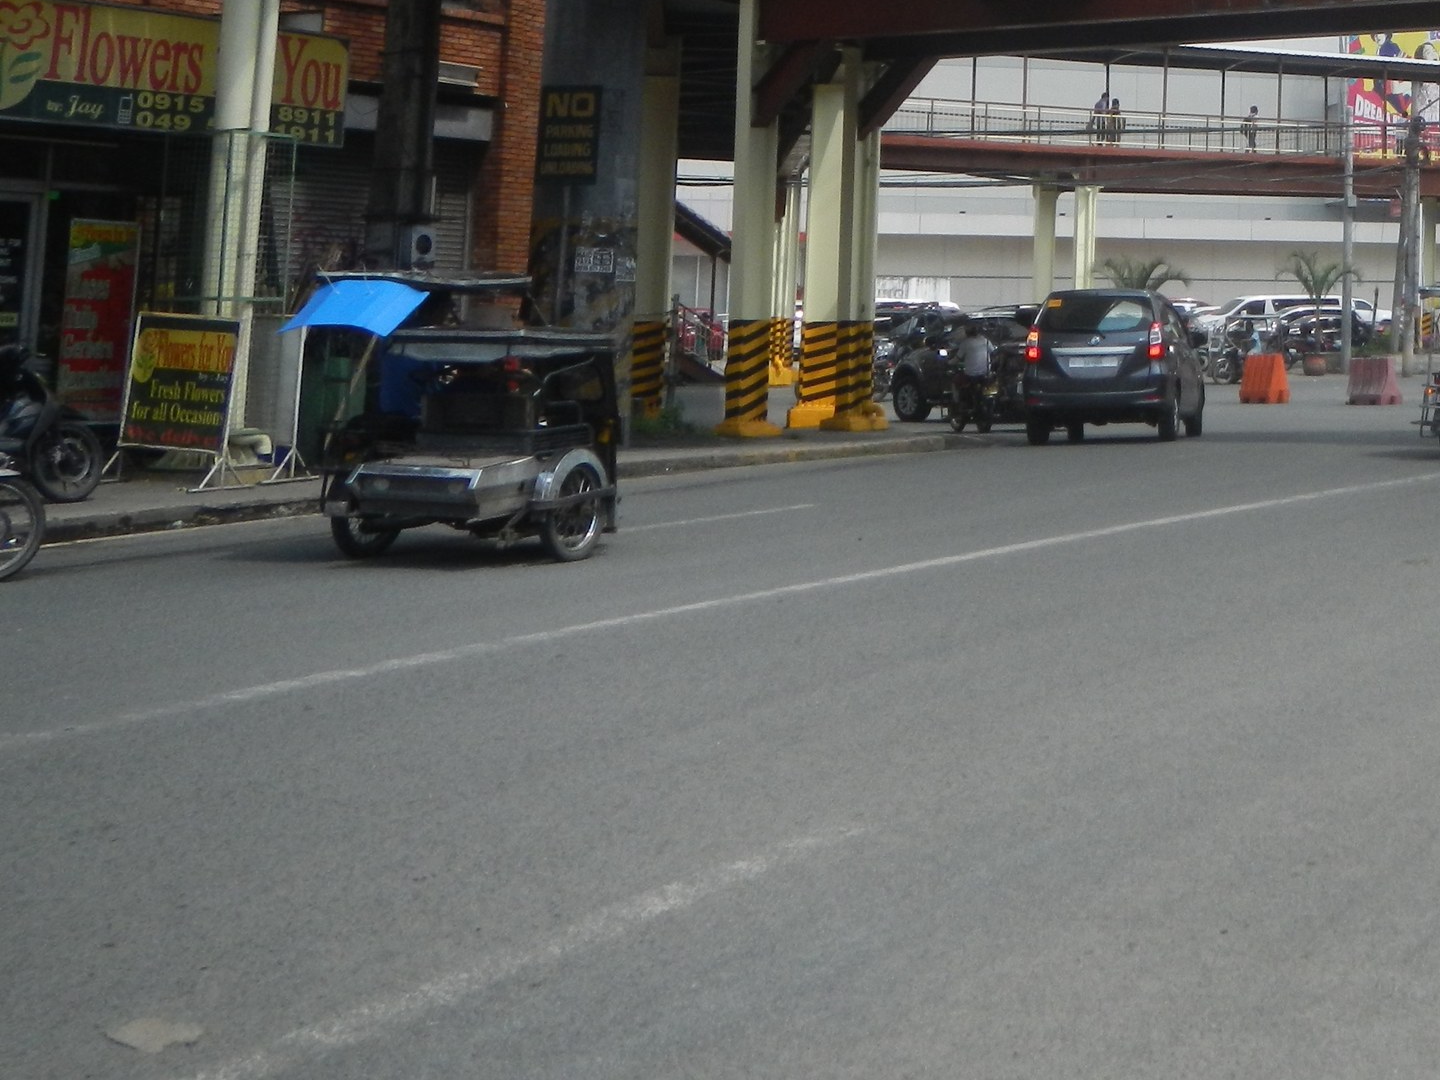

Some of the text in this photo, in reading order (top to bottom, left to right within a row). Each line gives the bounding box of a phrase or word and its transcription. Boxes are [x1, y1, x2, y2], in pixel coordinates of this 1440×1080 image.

[43, 3, 342, 110] Flowers You
[64, 94, 104, 119] Jay
[137, 91, 336, 126] 0915 8911
[546, 92, 595, 118] NO
[135, 110, 192, 131] 049
[545, 123, 594, 139] PARKING
[543, 143, 592, 158] LOADING
[540, 160, 594, 176] UNLOADING
[155, 331, 196, 369] Flowers
[198, 331, 214, 371] for
[150, 379, 225, 403] Fresh Flowers
[131, 400, 149, 420] for
[152, 402, 167, 421] all
